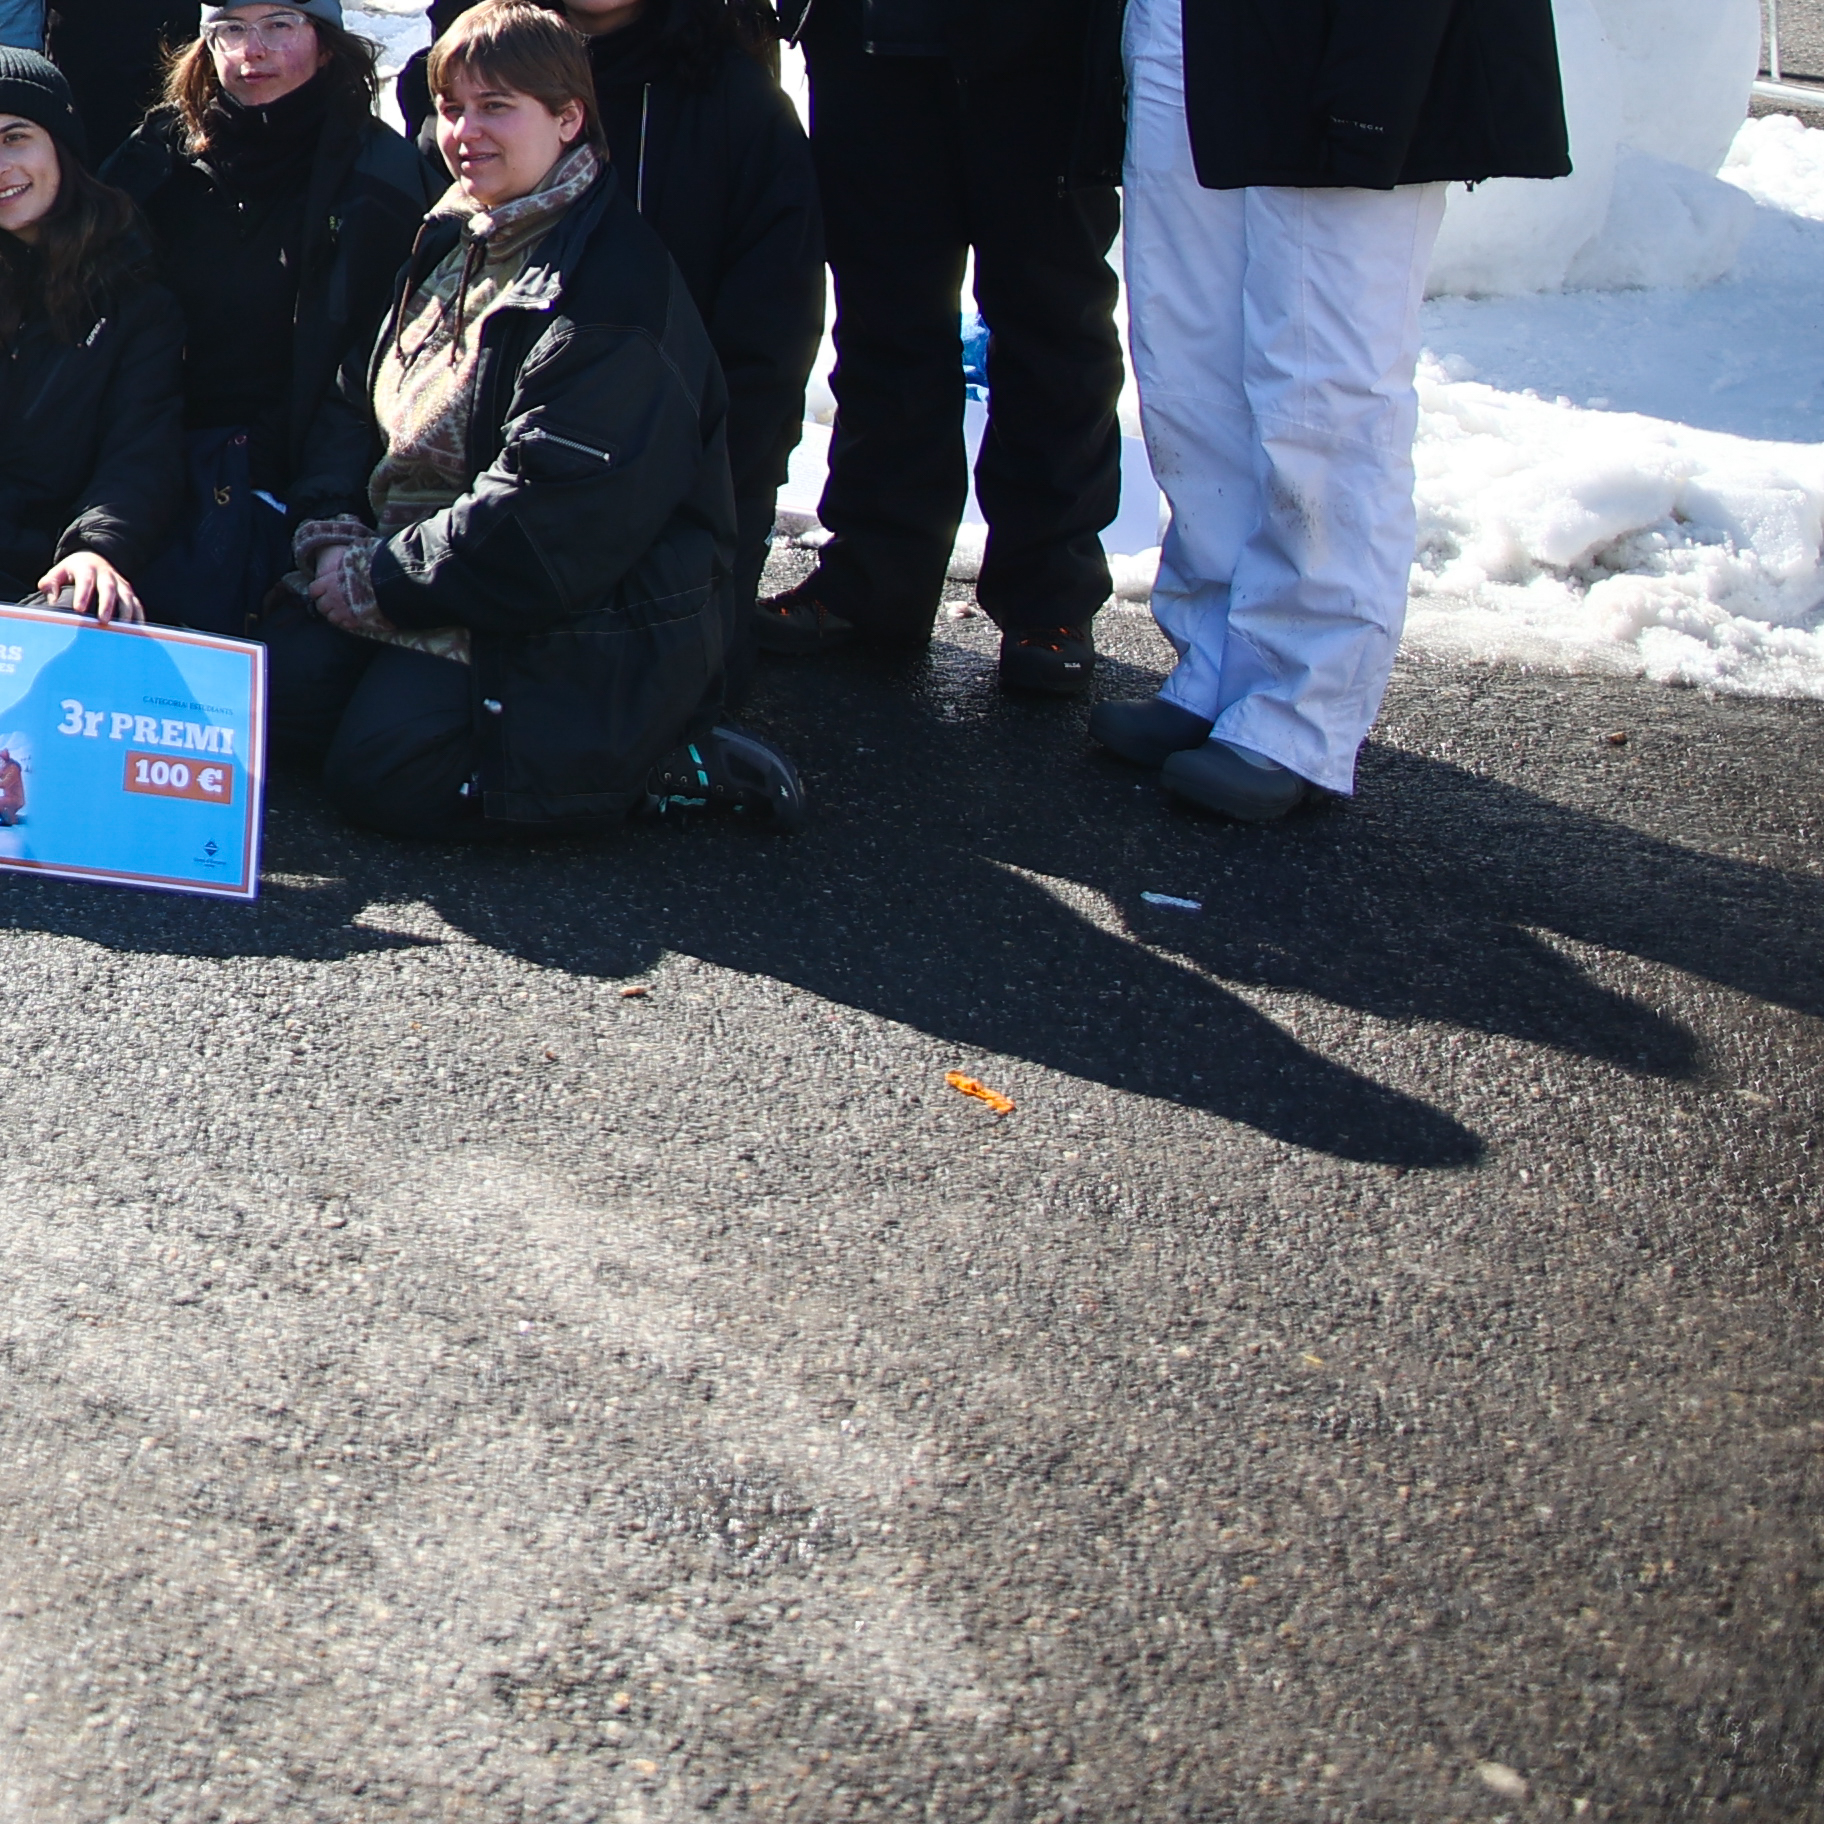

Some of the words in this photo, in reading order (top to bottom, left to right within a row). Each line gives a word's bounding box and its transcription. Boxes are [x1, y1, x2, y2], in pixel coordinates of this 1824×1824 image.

[57, 698, 105, 737] 3r
[108, 712, 235, 755] PREMI
[135, 759, 190, 788] 100
[197, 768, 224, 794] €
